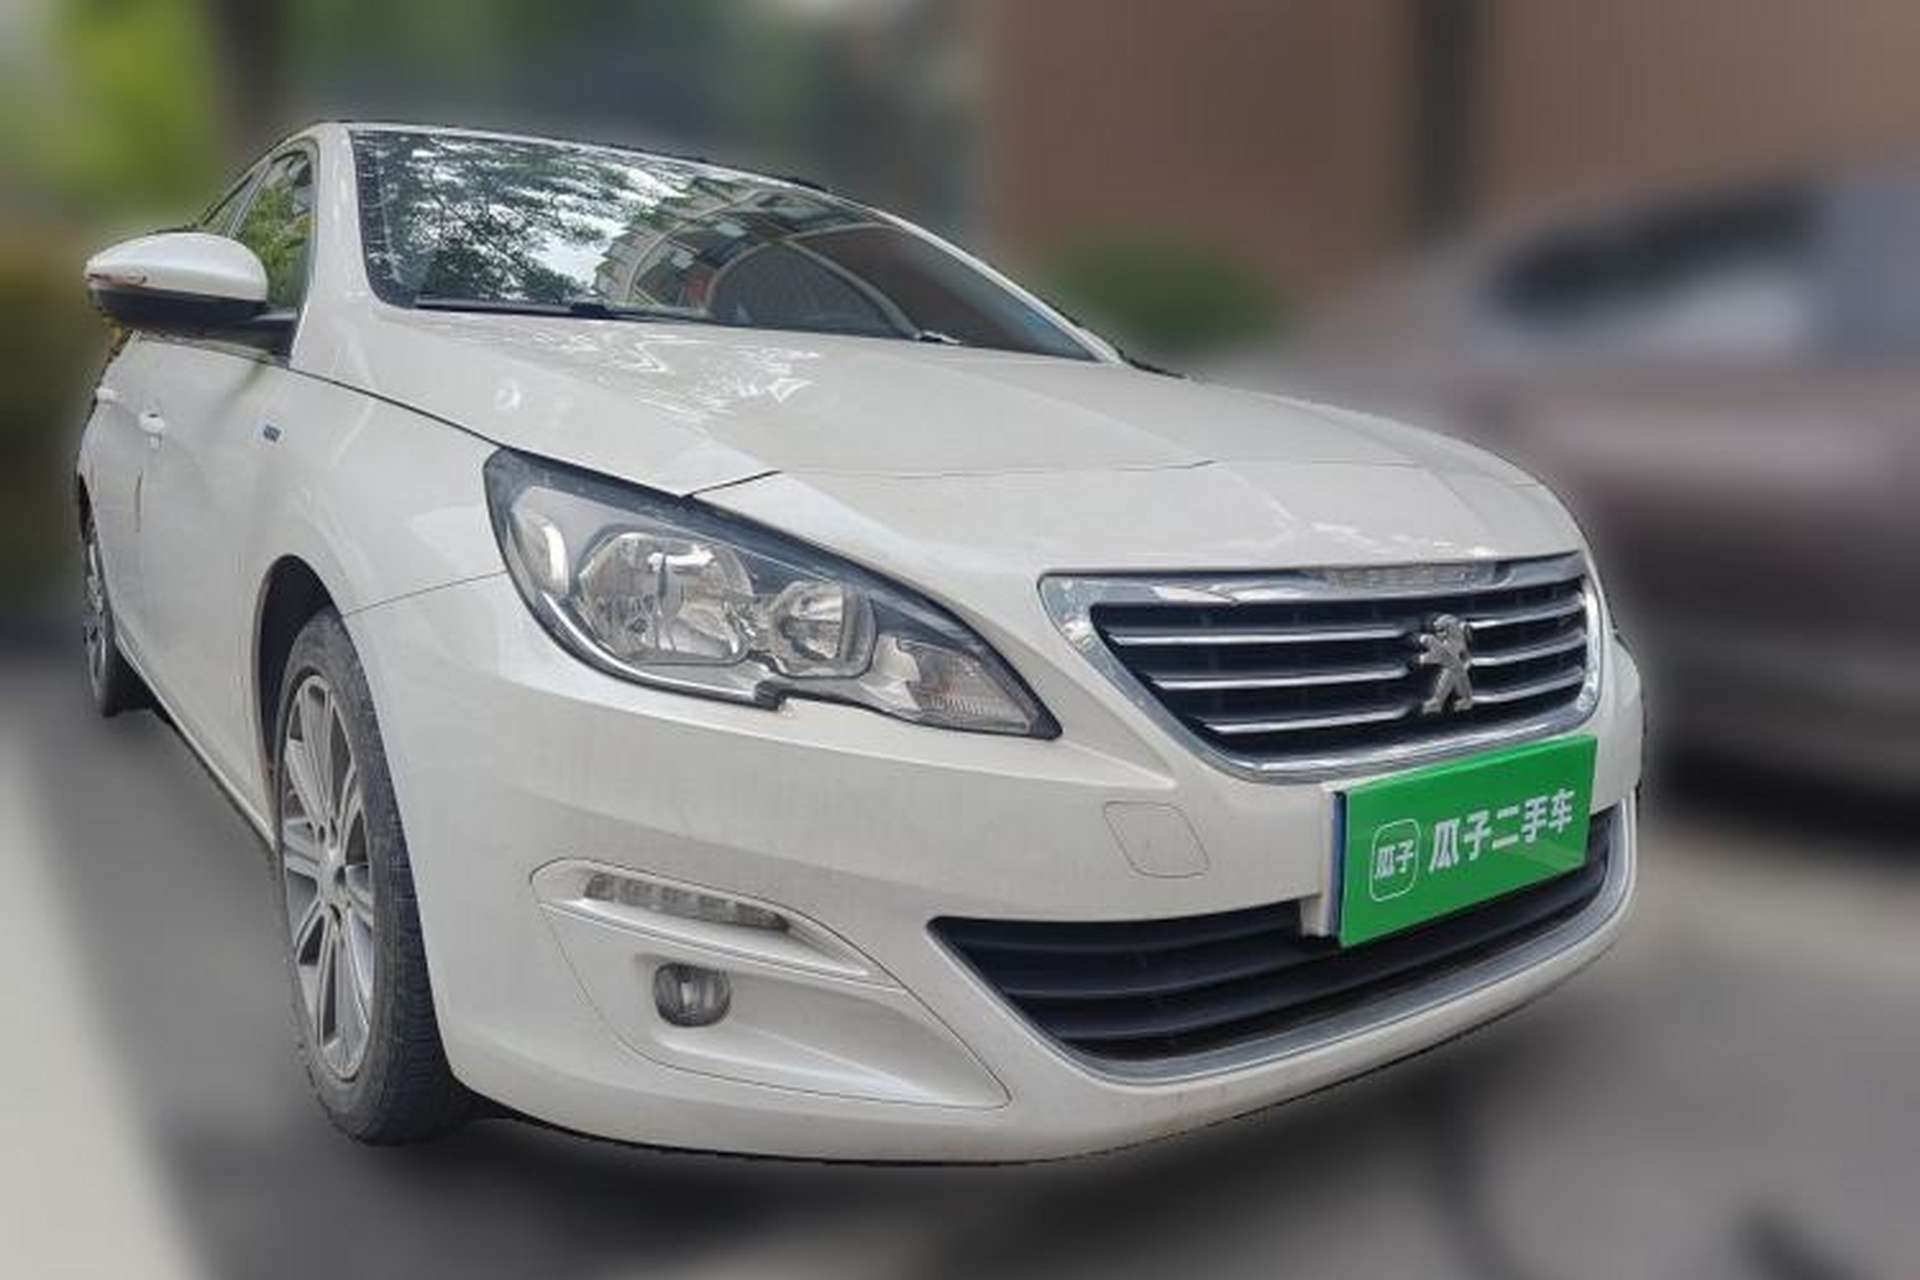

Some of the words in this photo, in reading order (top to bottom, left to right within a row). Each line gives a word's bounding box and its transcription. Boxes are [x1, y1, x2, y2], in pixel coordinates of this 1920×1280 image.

[1374, 839, 1414, 879] 瓜子
[1429, 788, 1575, 873] 瓜子二手车
